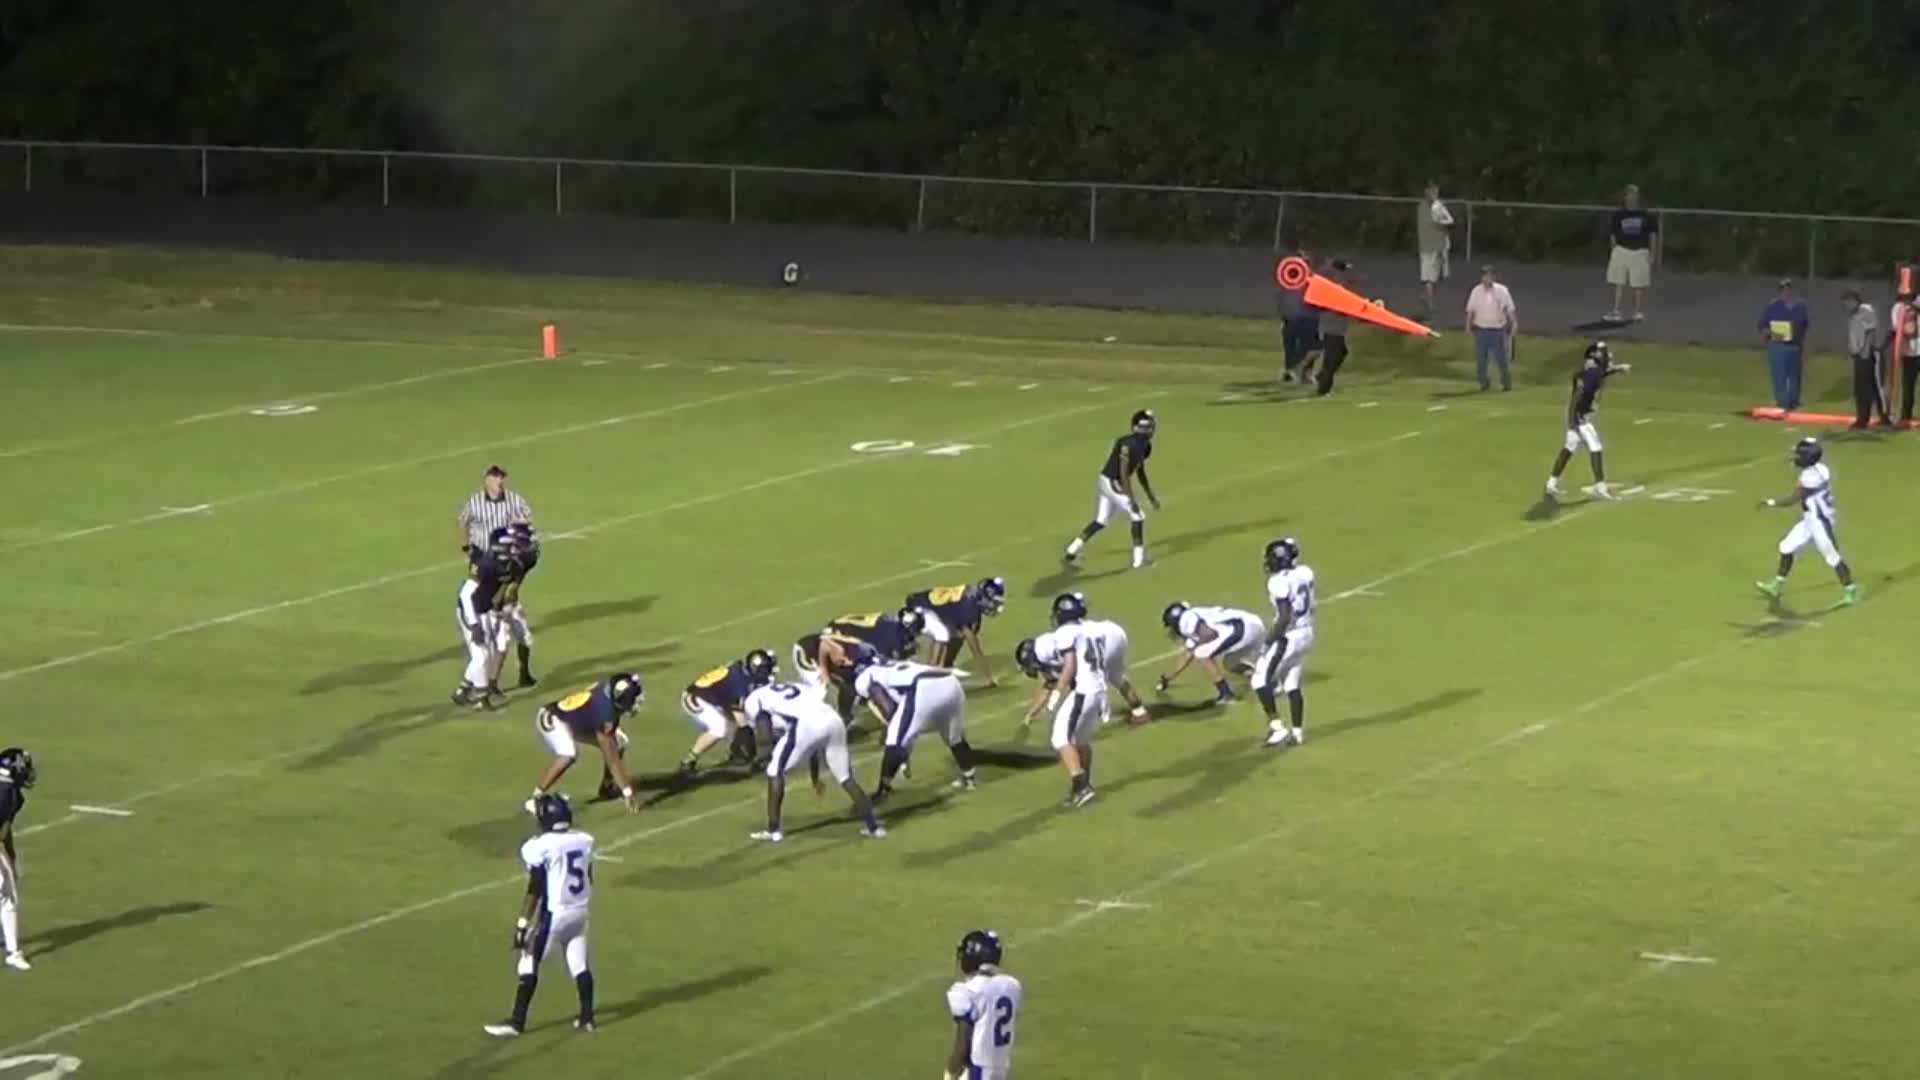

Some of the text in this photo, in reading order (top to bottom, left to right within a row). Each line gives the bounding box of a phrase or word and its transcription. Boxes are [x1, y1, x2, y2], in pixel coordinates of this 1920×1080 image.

[784, 262, 798, 282] G
[565, 849, 584, 896] 5
[993, 995, 1013, 1047] 2
